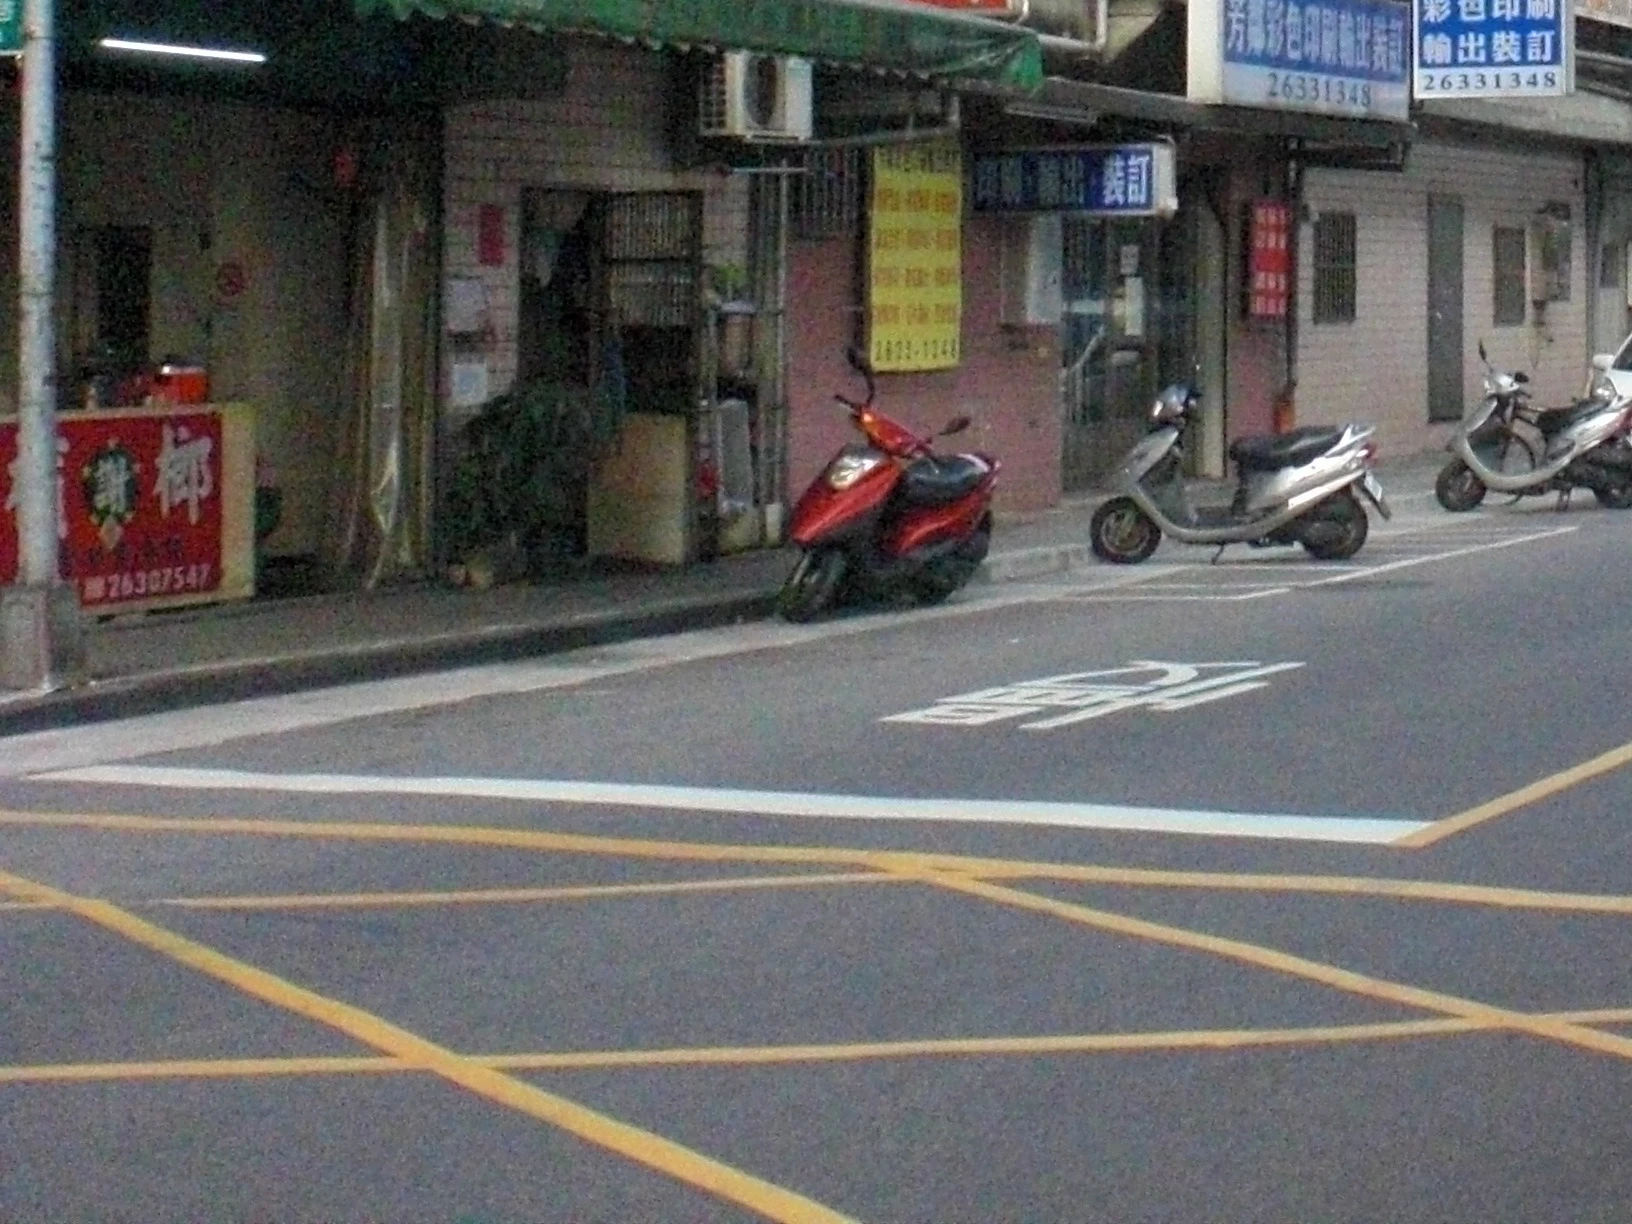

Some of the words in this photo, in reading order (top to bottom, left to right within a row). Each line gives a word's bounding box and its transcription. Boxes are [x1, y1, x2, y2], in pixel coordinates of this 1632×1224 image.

[1422, 30, 1556, 64] 輸出裝訂
[1267, 72, 1372, 108] 26331348
[1423, 72, 1556, 90] 26331348
